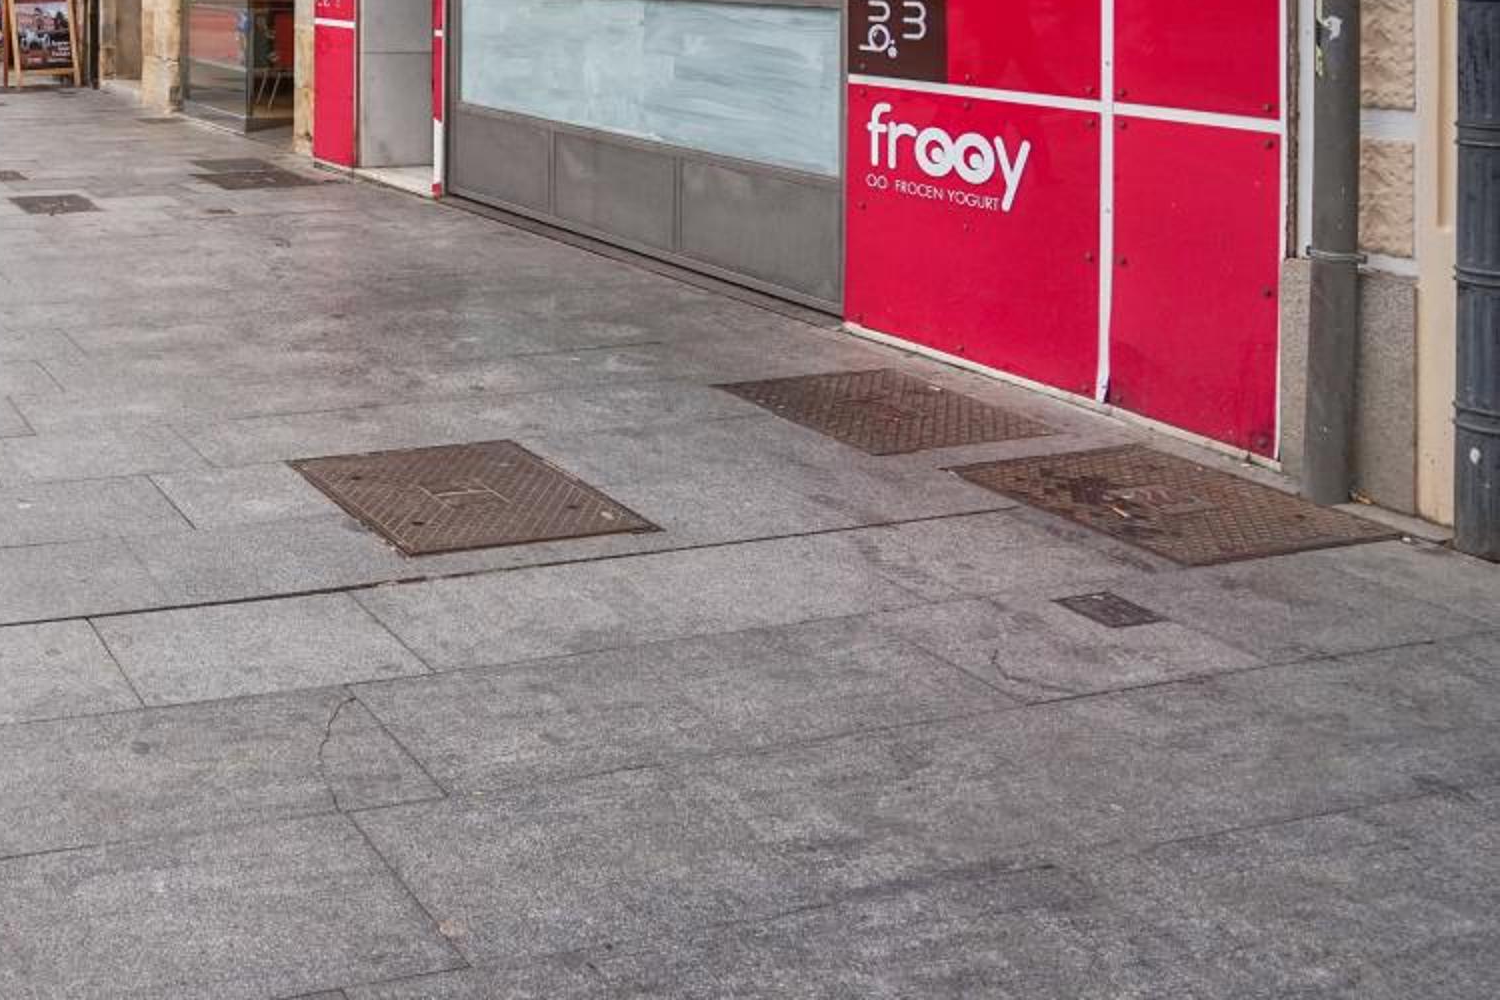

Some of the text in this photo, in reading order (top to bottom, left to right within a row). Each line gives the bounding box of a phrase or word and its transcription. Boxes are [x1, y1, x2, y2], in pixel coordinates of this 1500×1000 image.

[866, 102, 1032, 213] frooy
[894, 179, 944, 200] FROCEN
[946, 188, 1000, 212] YOGURT
